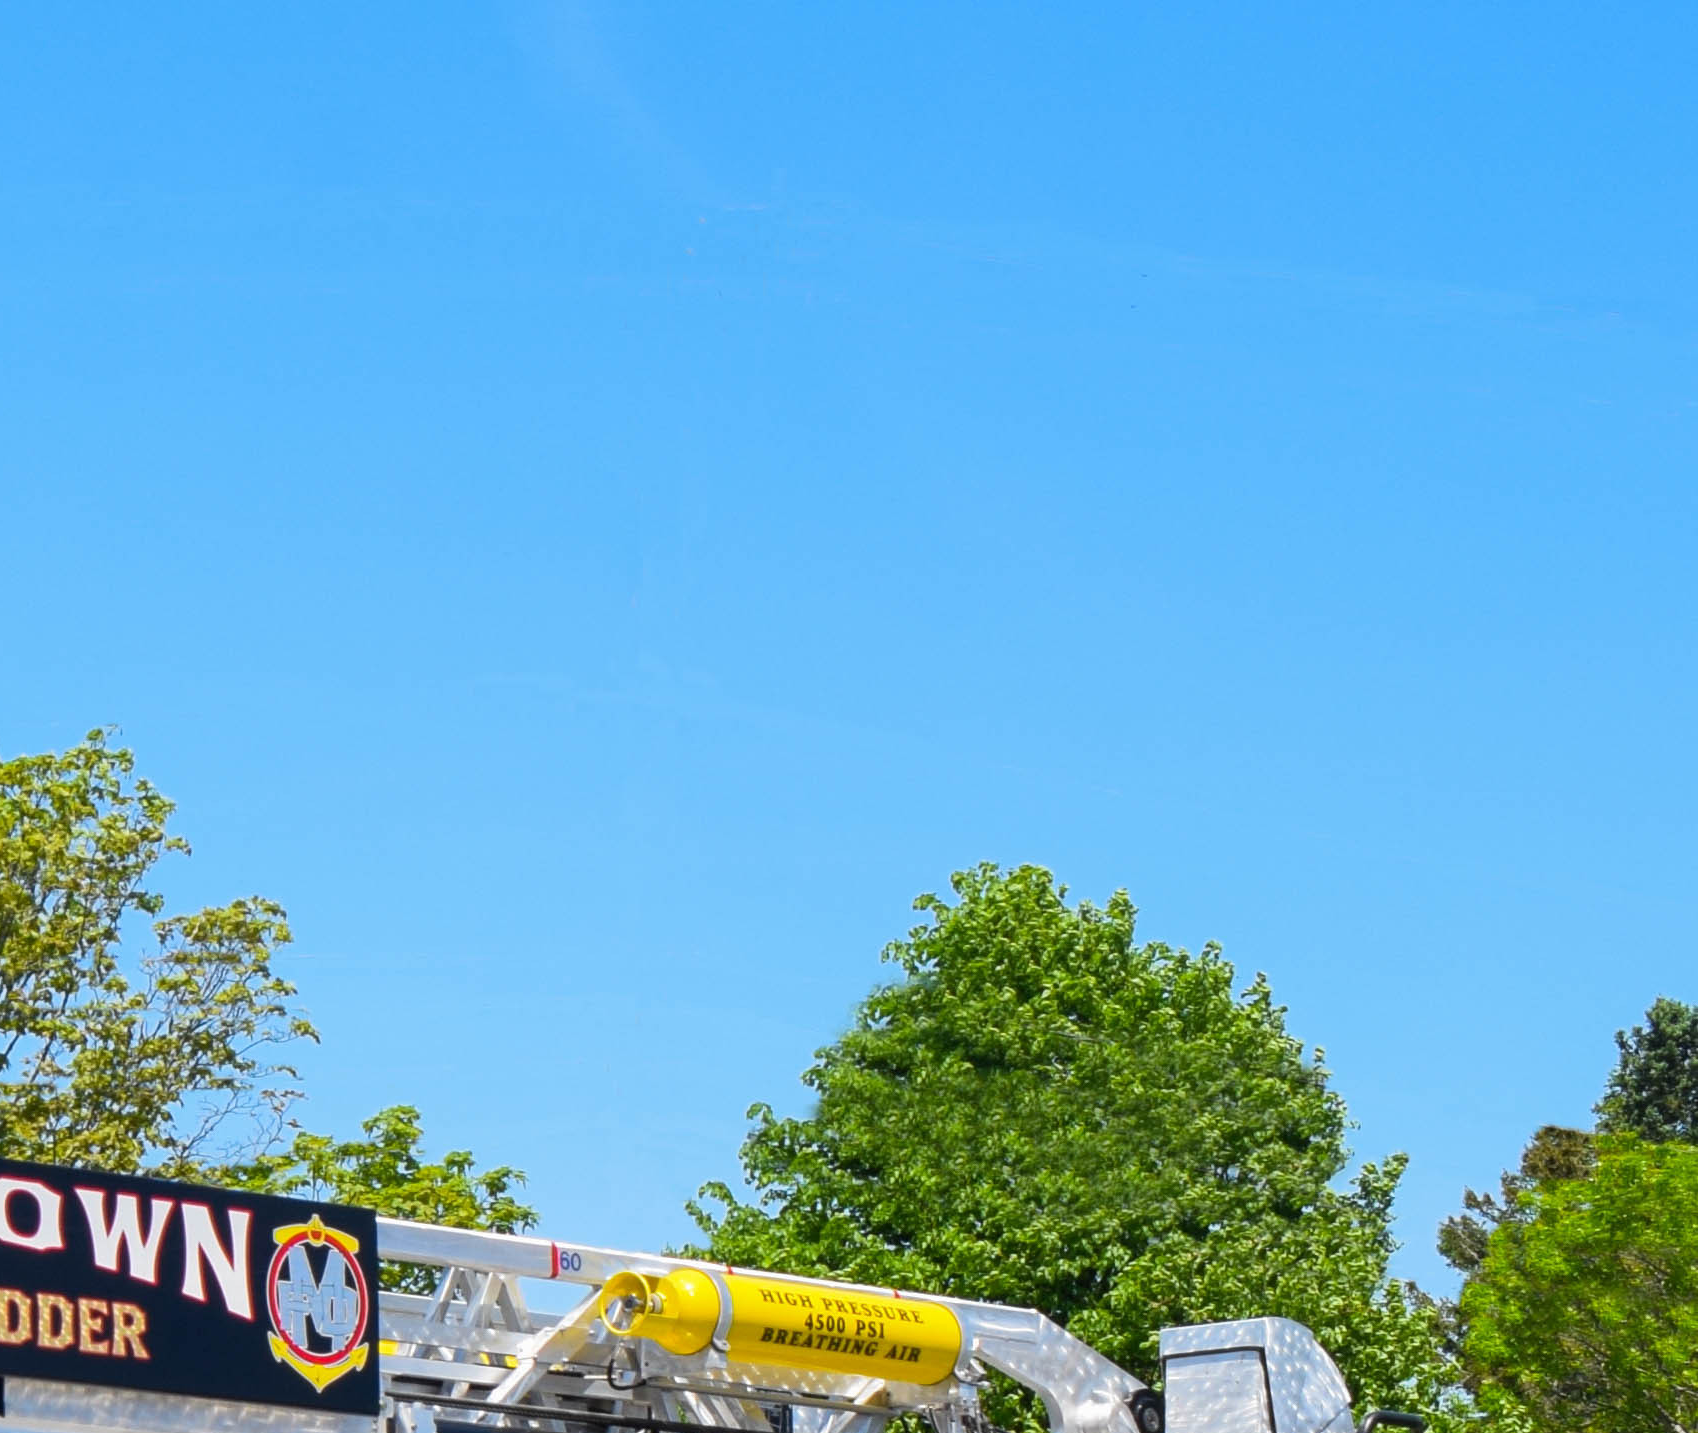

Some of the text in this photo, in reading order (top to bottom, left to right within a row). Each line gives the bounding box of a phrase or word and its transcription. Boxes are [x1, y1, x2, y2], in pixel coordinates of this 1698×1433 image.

[560, 1251, 581, 1271] 60
[759, 1288, 924, 1324] HIGH PRESSURE
[804, 1313, 885, 1339] 4500 PSI
[760, 1327, 922, 1363] BREATHING AIR
